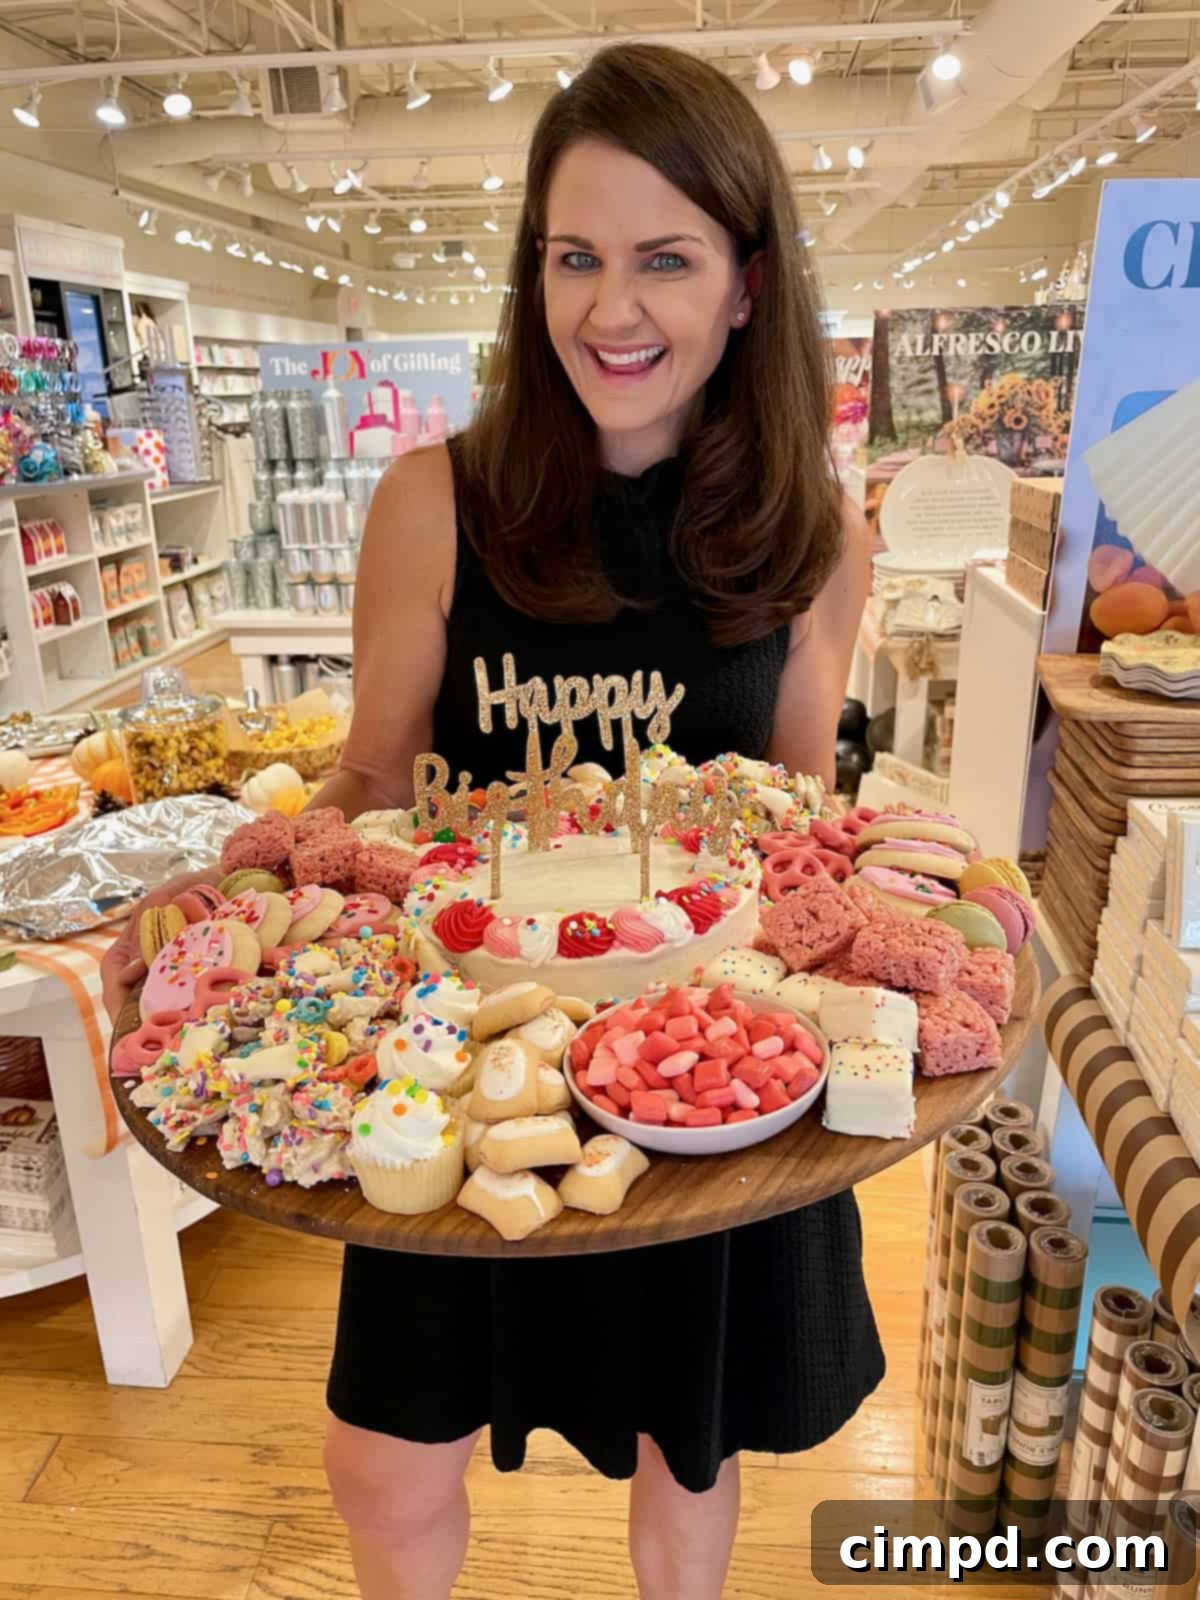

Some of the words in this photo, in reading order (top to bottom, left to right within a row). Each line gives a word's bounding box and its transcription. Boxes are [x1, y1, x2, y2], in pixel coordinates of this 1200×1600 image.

[269, 356, 308, 377] The
[310, 349, 372, 382] JOY
[370, 354, 394, 373] of
[393, 352, 462, 375] Gifting
[895, 330, 1042, 357] ALFRESCO
[473, 652, 685, 751] Happy
[413, 752, 743, 856] Birthday
